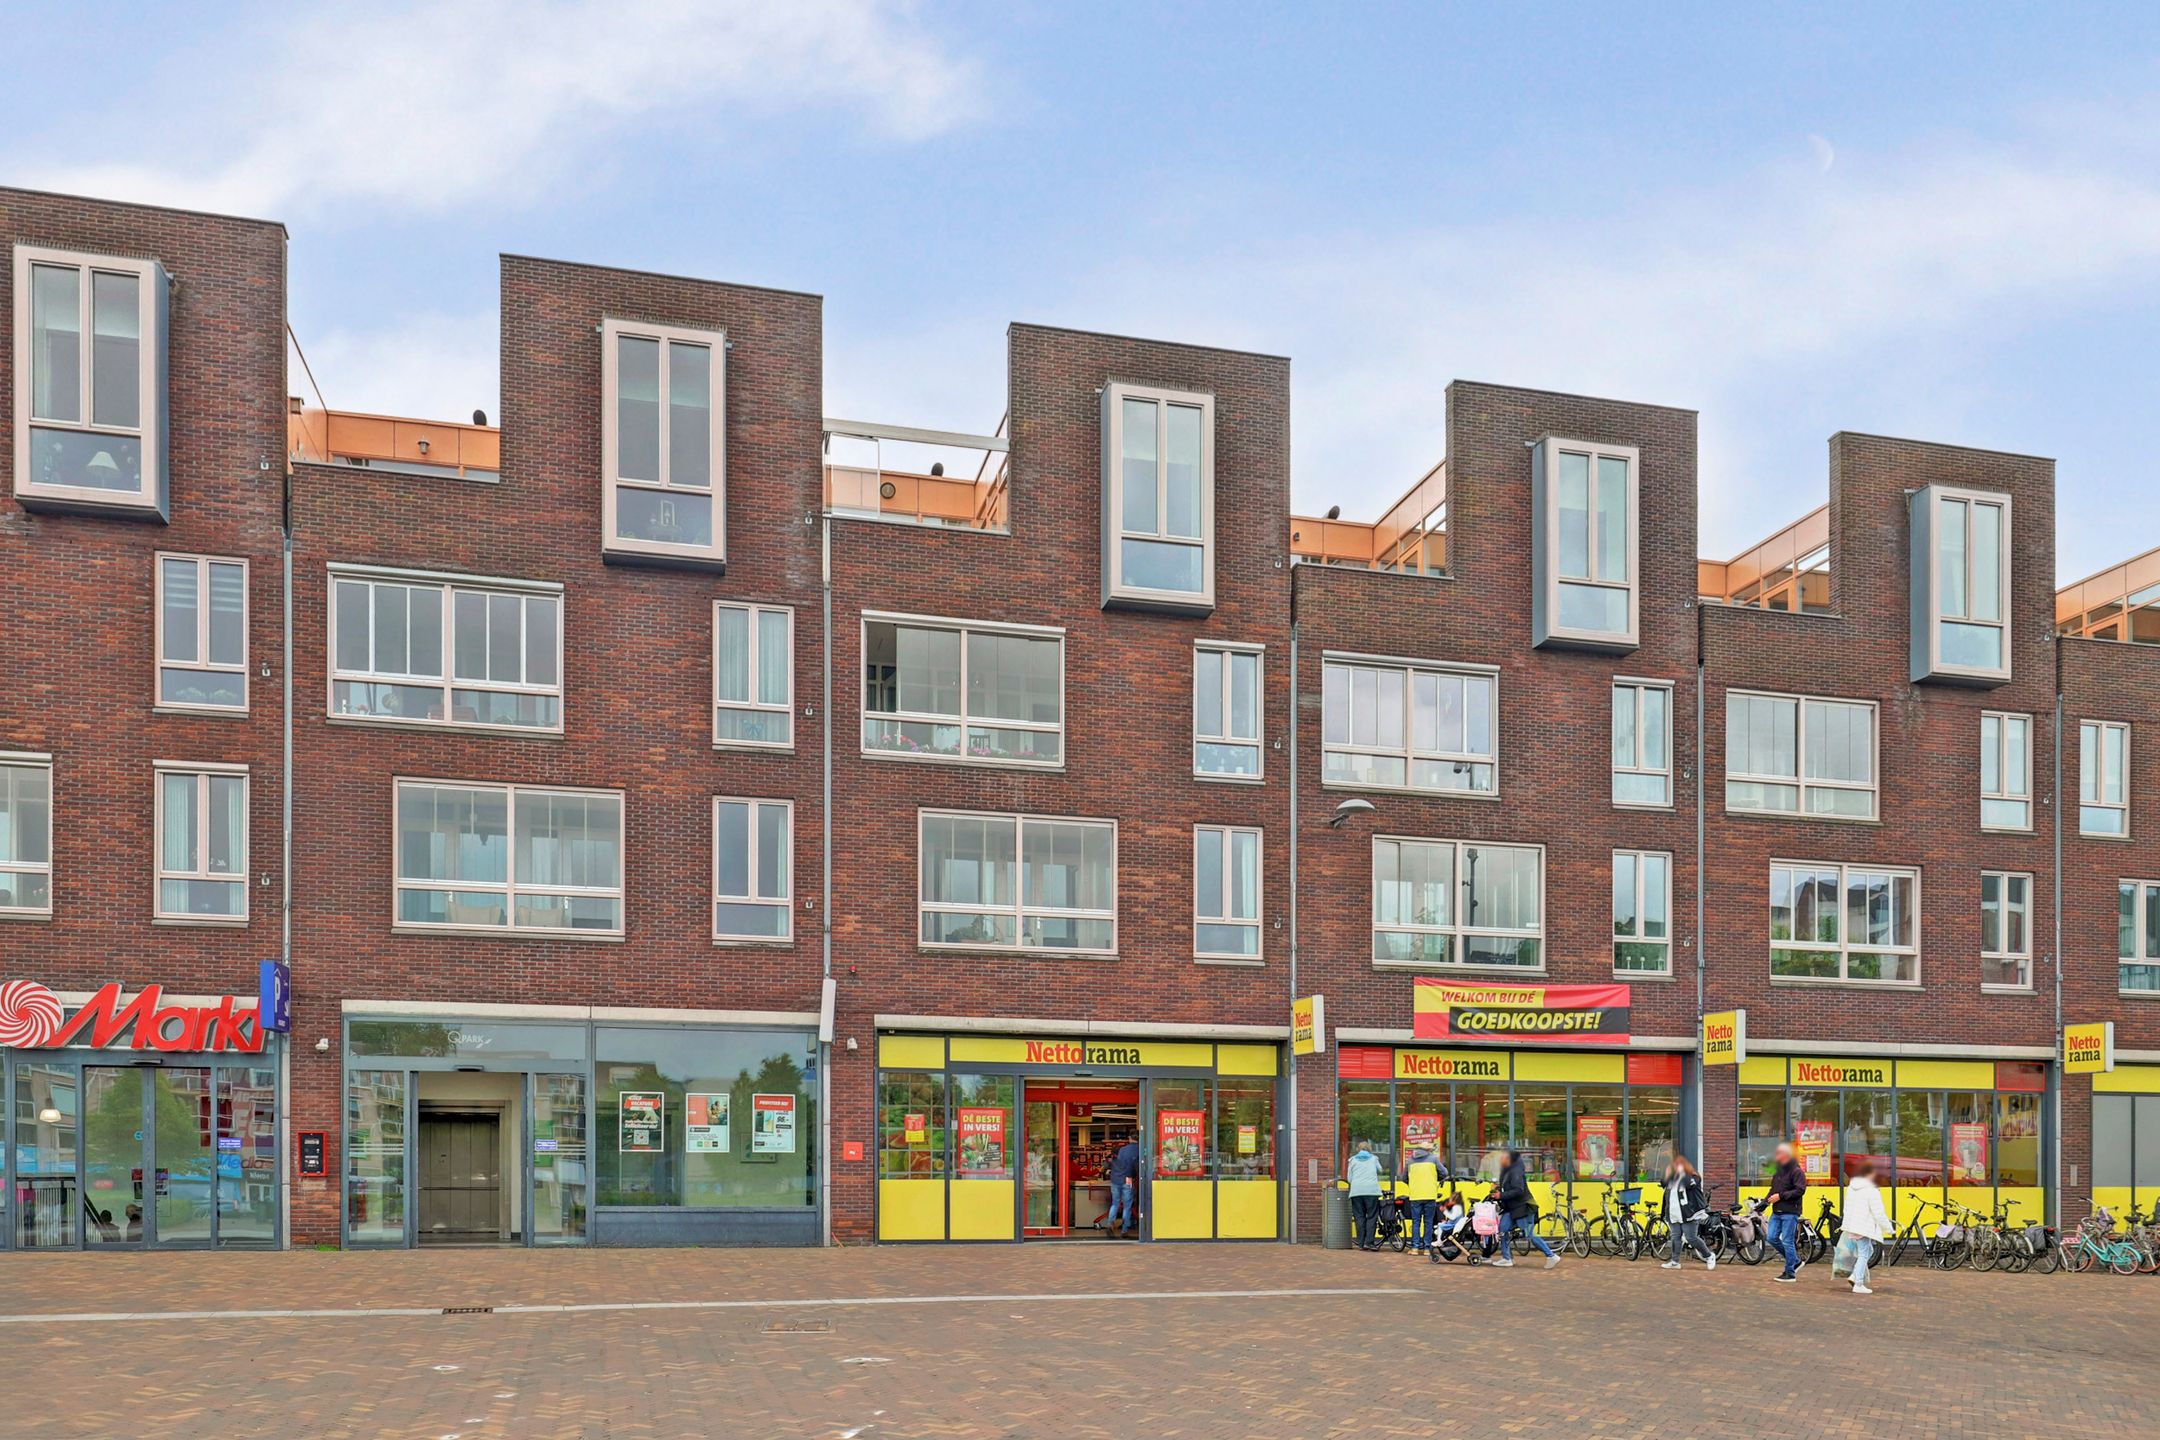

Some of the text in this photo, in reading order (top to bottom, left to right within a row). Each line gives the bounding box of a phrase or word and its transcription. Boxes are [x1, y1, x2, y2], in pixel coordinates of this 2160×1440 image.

[1441, 990, 1536, 1004] WELKOM BIJ DÉ
[1295, 1011, 1312, 1028] Netto
[1456, 1011, 1602, 1030] GOEDKOOPSTE!
[1295, 1027, 1312, 1042] rama
[1706, 1024, 1733, 1041] Netto
[1706, 1039, 1733, 1053] rama
[2068, 1036, 2101, 1051] Netto
[2068, 1049, 2101, 1062] rama
[1403, 1054, 1500, 1076] Nettorama
[1797, 1063, 1883, 1083] Nettorama
[962, 1113, 1001, 1123] DÉ BESTE
[1077, 1106, 1084, 1116] 3
[963, 1123, 1000, 1132] IN VERS!
[1163, 1116, 1200, 1126] DÉ BESTE
[1164, 1126, 1199, 1134] IN VERS!
